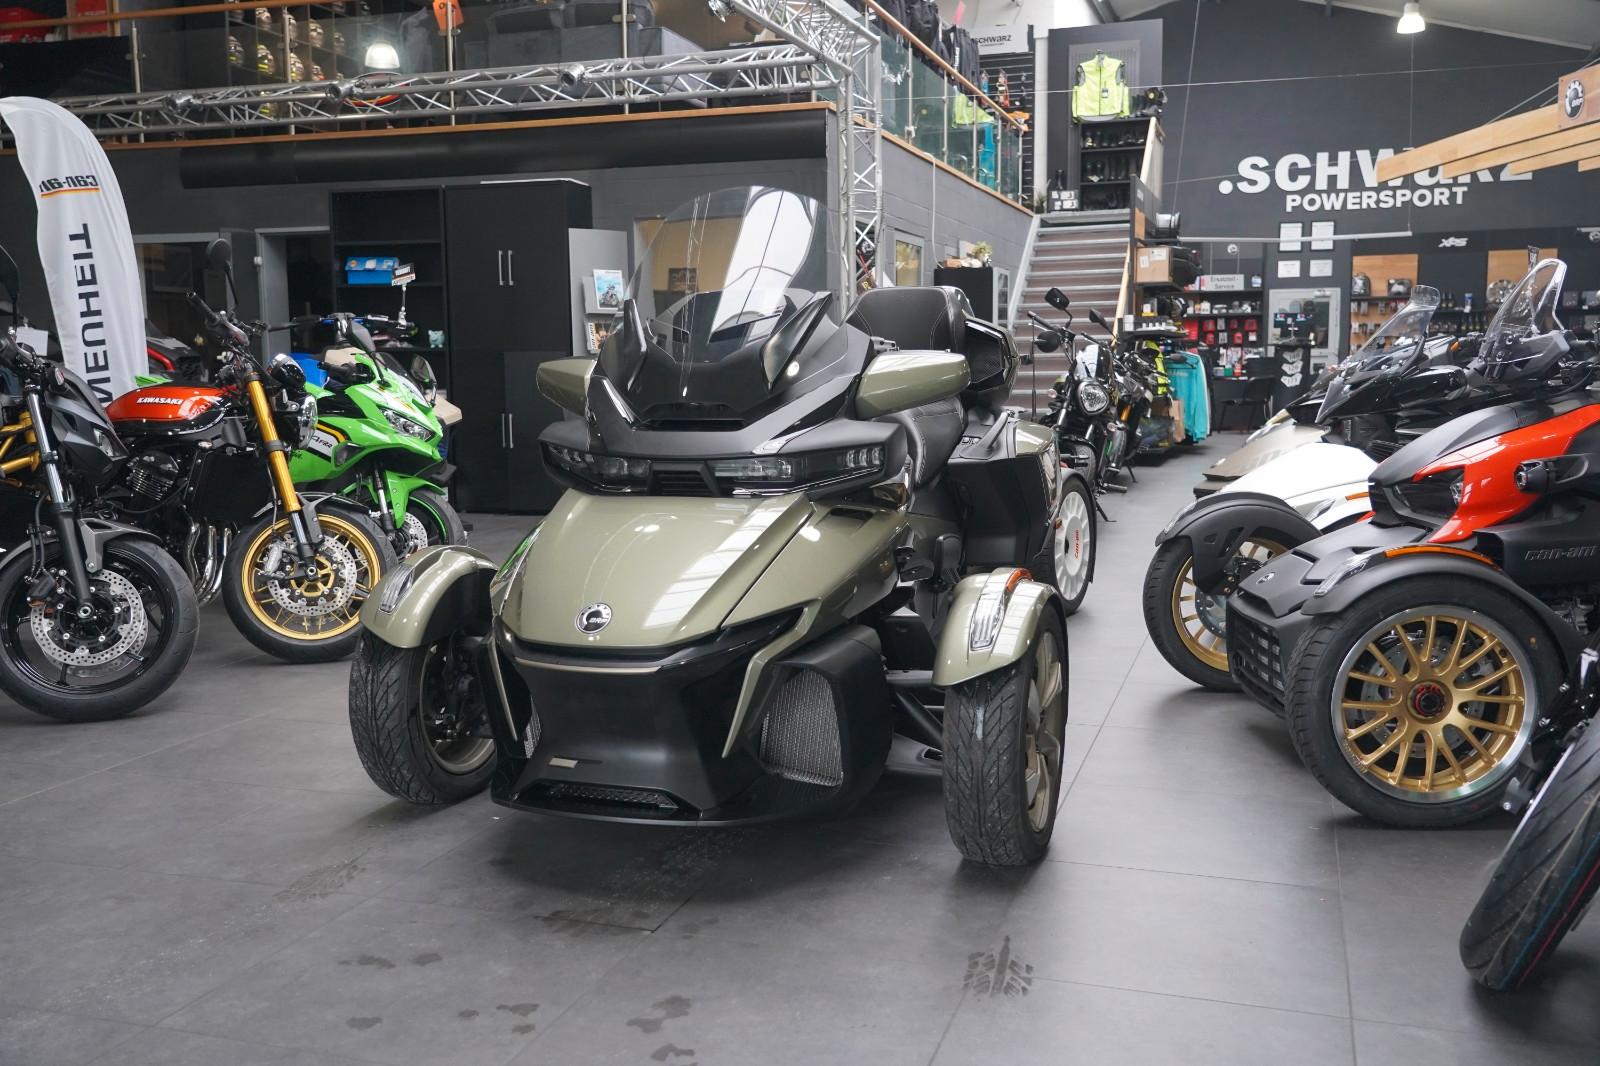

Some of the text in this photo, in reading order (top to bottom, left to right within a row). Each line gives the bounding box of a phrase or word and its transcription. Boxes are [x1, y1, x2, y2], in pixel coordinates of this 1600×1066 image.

[1285, 186, 1468, 212] POWERSPORT
[136, 397, 184, 405] KAWASAKI
[1524, 545, 1597, 561] can-am
